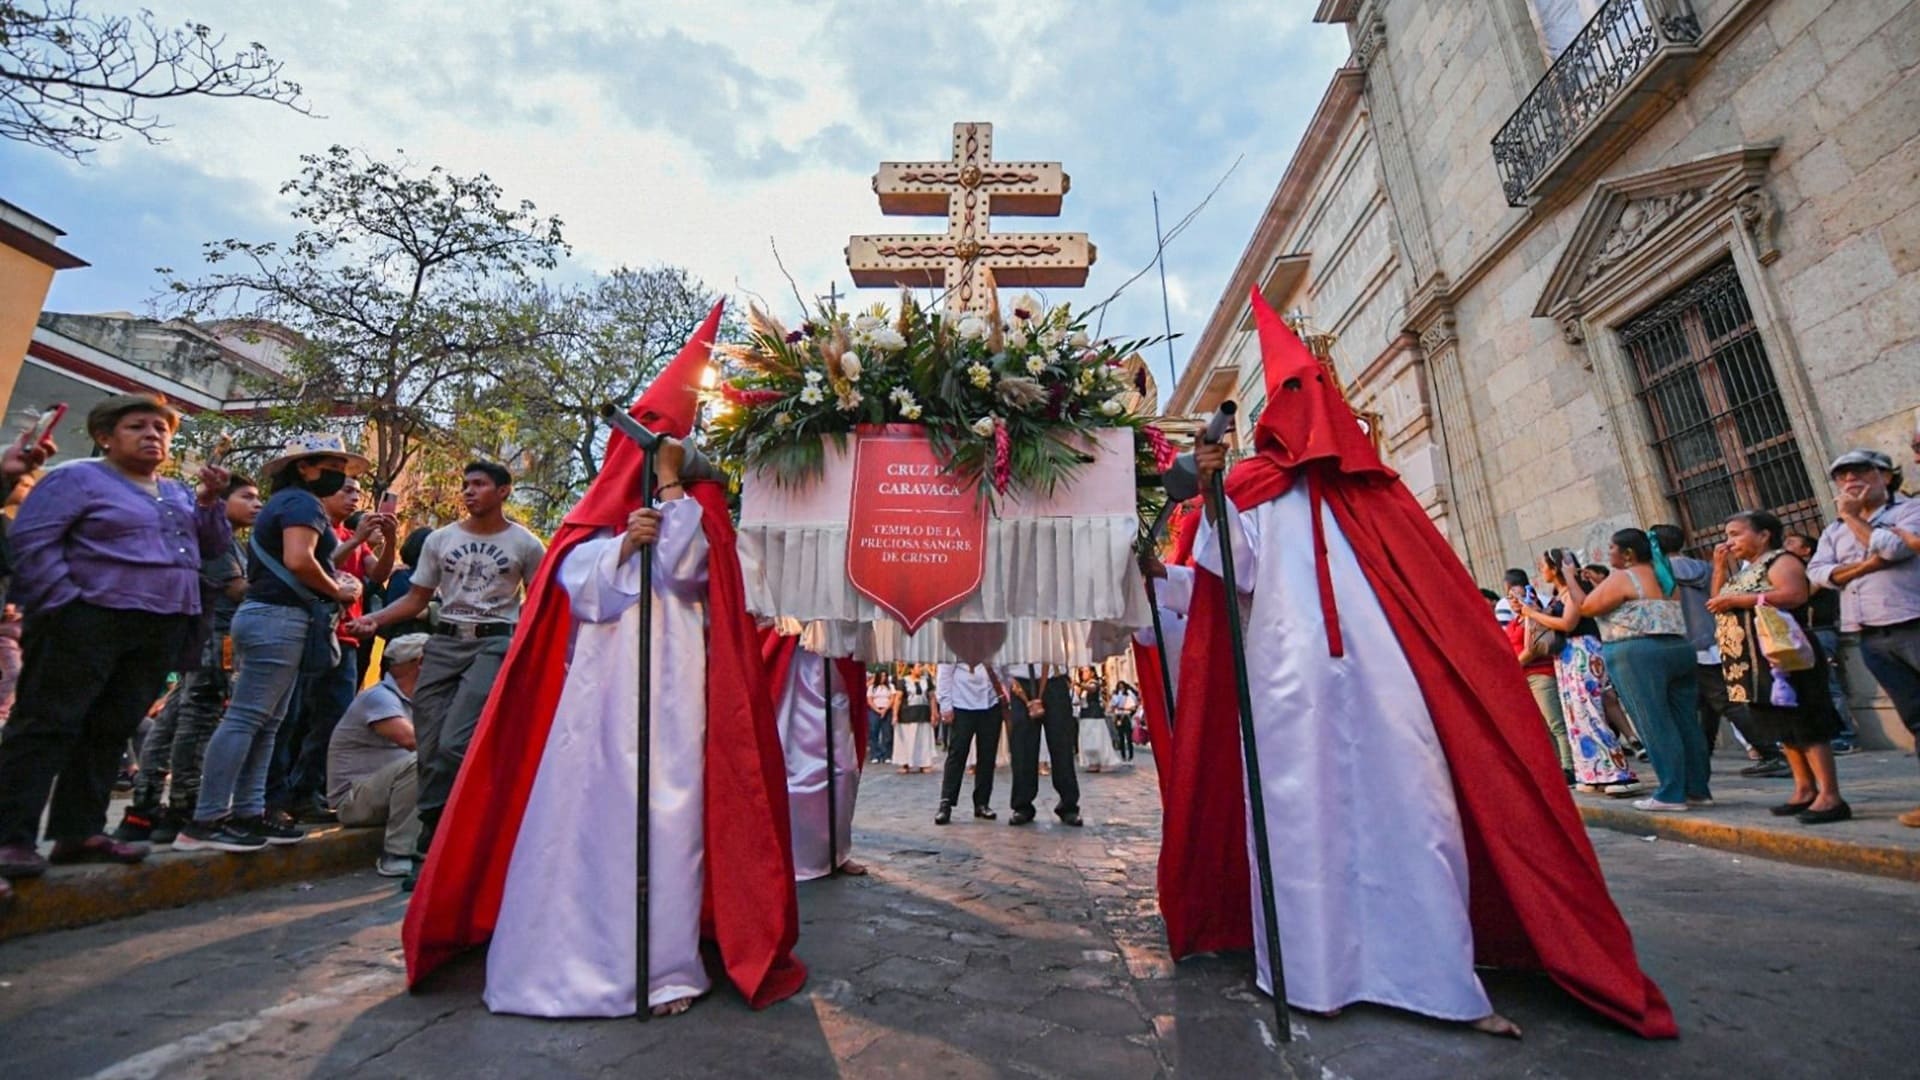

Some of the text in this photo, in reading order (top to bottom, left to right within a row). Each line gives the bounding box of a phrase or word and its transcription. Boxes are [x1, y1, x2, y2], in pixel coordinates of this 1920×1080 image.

[887, 463, 929, 476] CRUZ
[878, 482, 960, 496] CARAVACA
[873, 524, 961, 537] TEMPLO DE LA
[860, 537, 972, 551] PRECIOSA SANGRE
[882, 551, 948, 564] DE CRISTO
